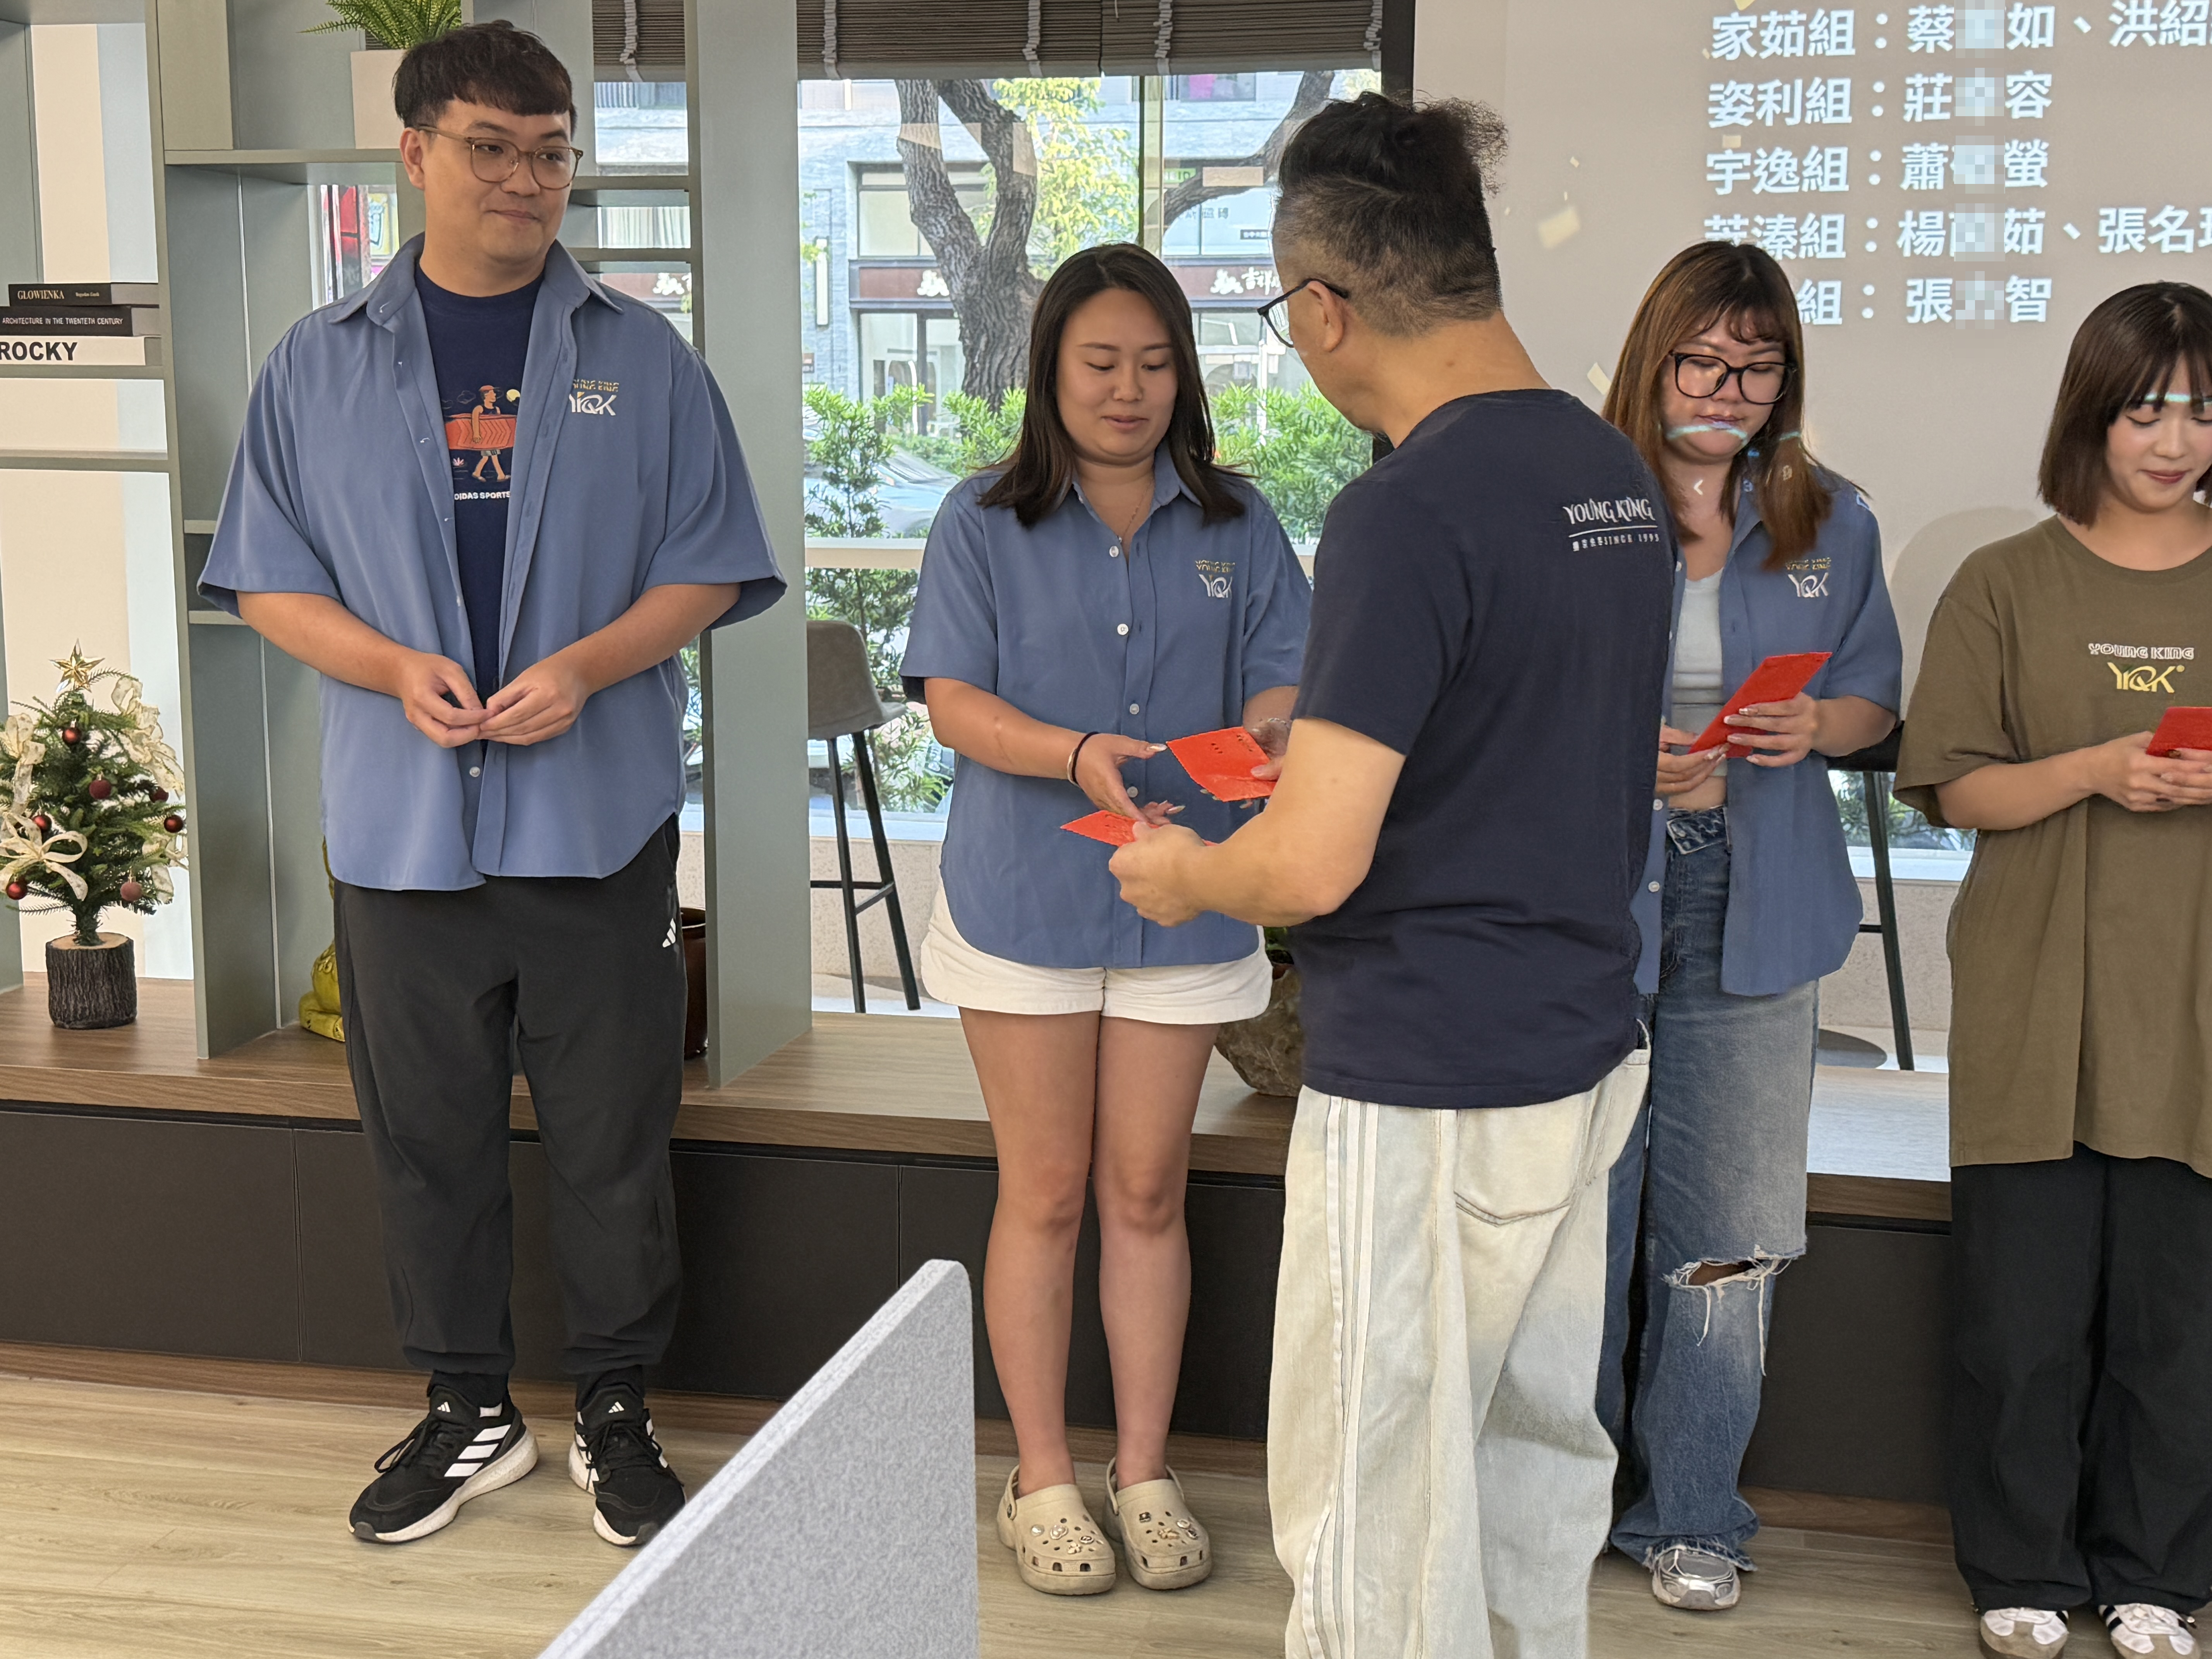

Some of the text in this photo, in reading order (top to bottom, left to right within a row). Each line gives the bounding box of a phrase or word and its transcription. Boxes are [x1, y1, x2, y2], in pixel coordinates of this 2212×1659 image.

[1711, 0, 2212, 60] 家茹組：蔡如、洪紹
[1708, 70, 2052, 128] 姿利組：莊容
[1705, 139, 2049, 195] 宇逸組：蕭螢
[17, 290, 65, 300] GLOWIENKA
[1796, 275, 2052, 325] 組：張智
[0, 341, 78, 361] ROCKY
[454, 492, 479, 500] DIDAS
[1563, 496, 1656, 524] YOUNG KING
[2088, 643, 2195, 660] YOUNG KING
